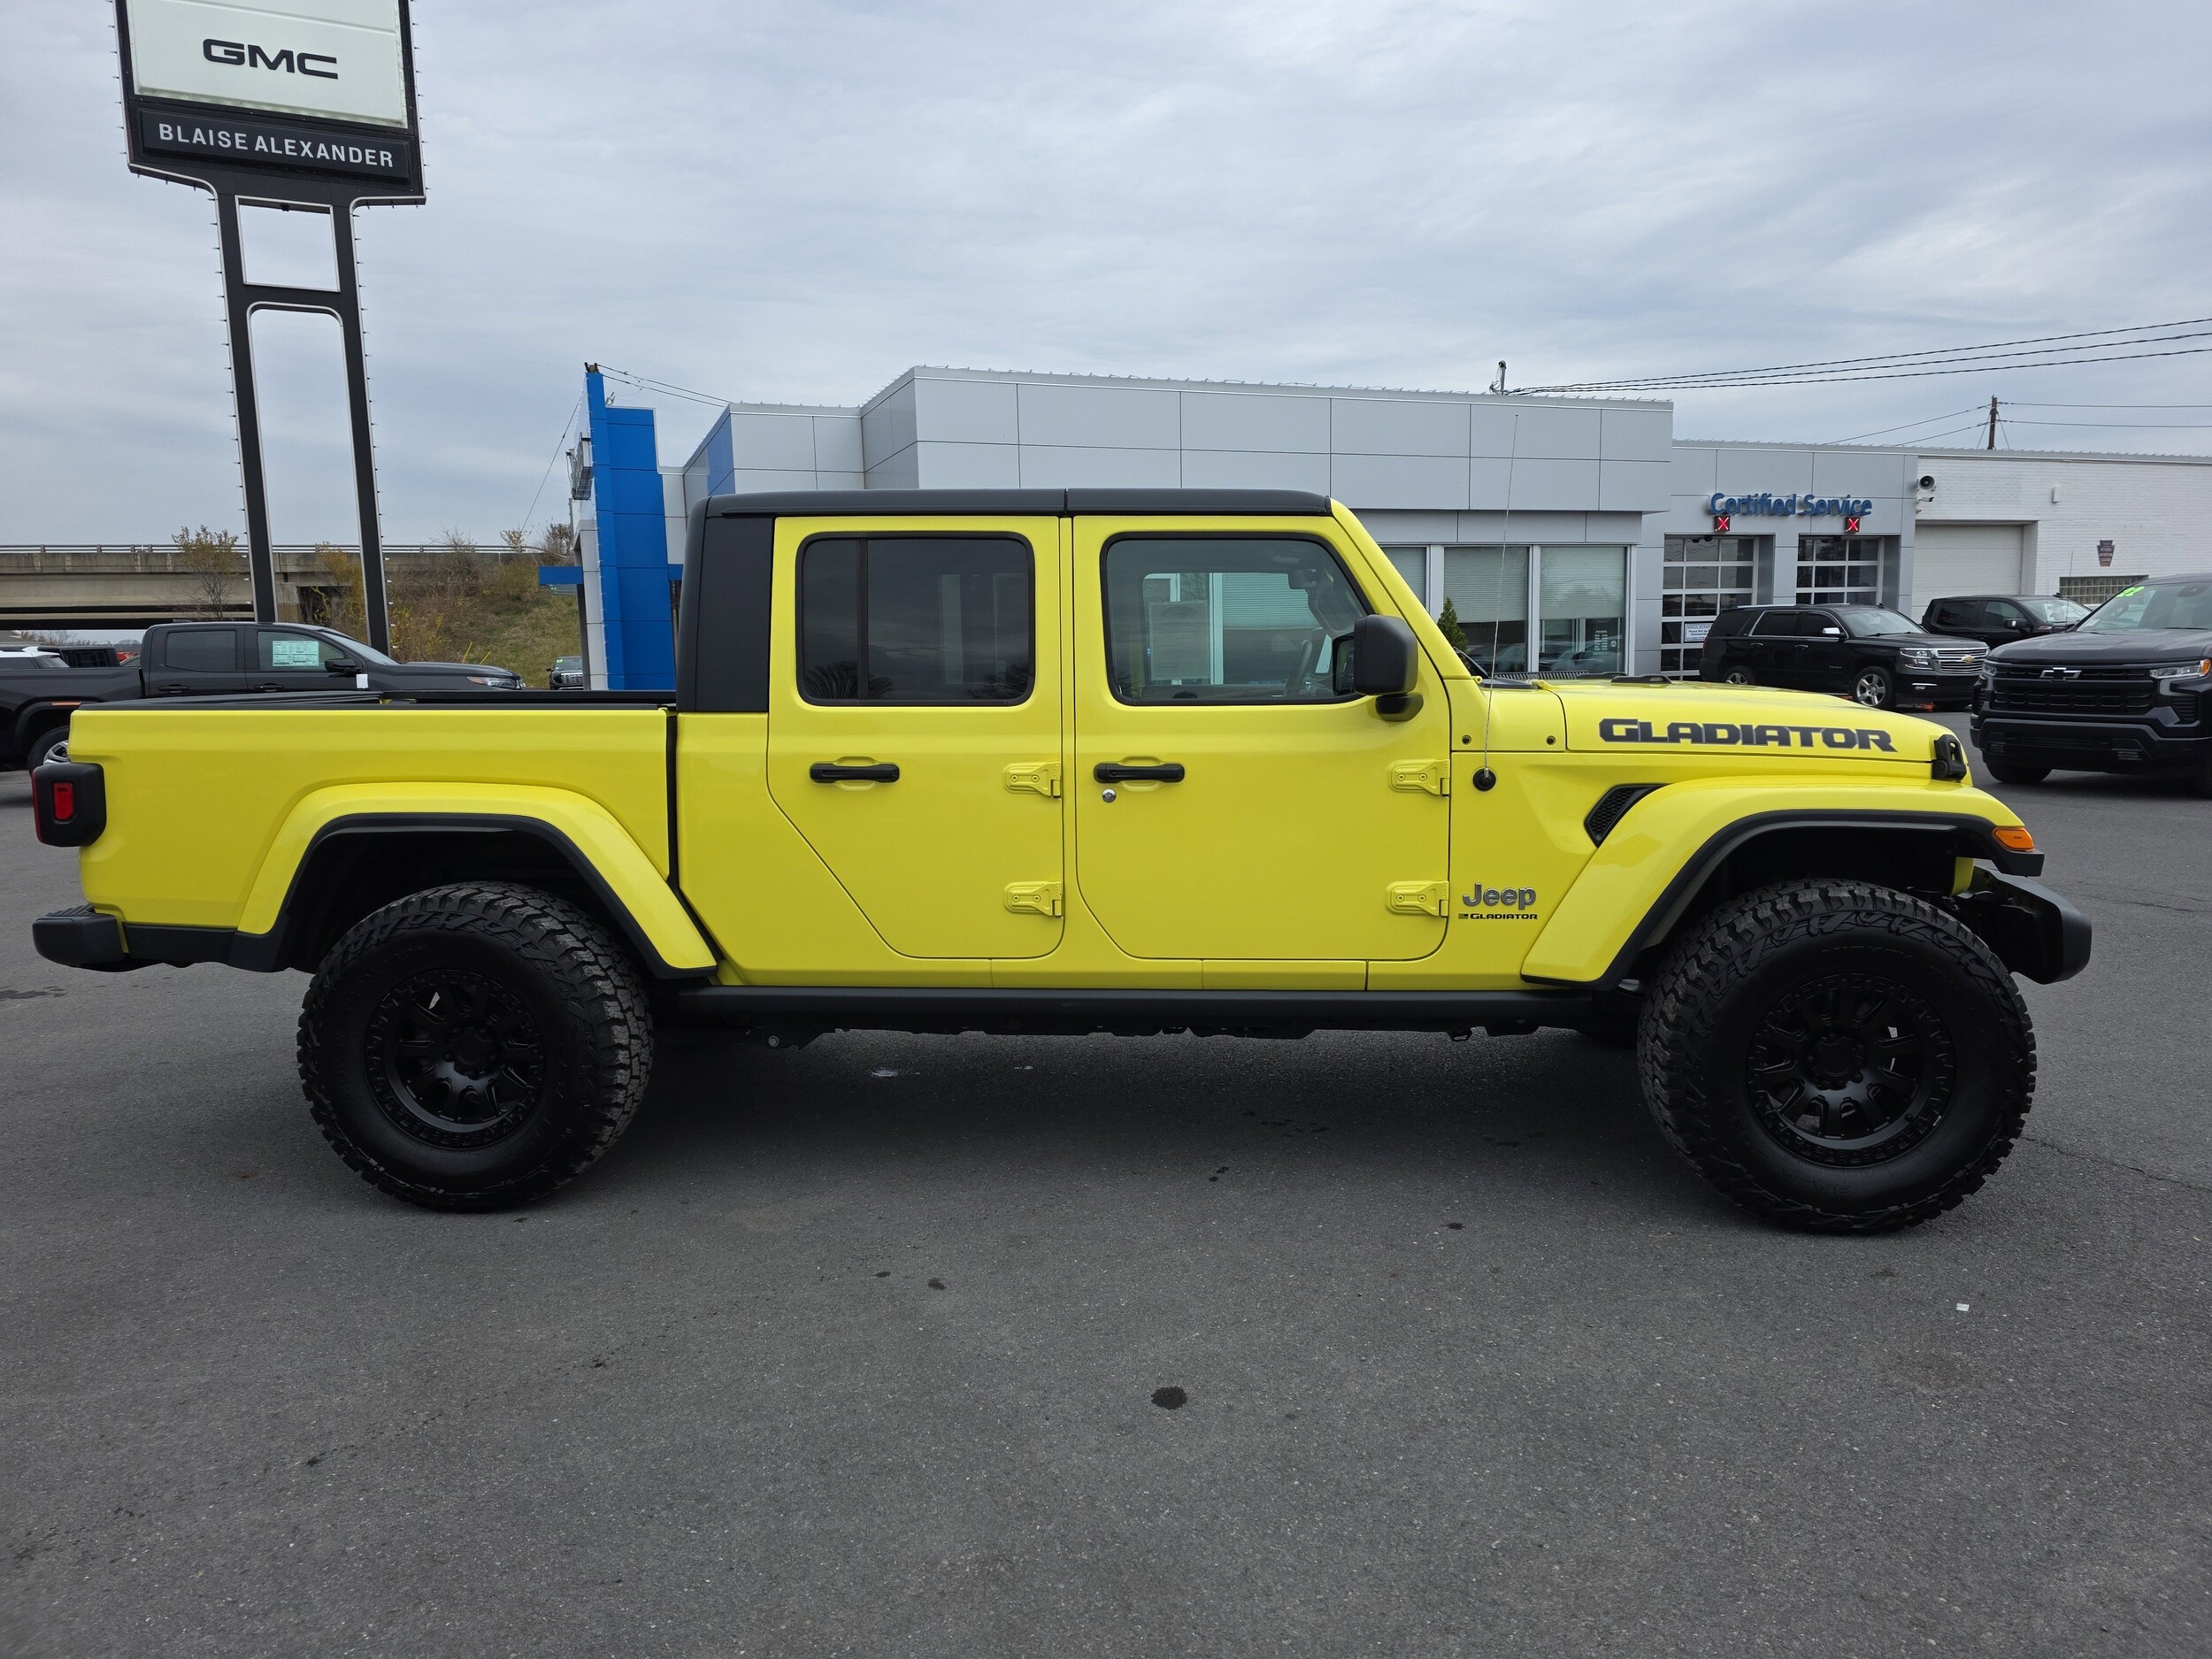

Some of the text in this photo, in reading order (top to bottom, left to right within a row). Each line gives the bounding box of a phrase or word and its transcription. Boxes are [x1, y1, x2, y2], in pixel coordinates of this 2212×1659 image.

[202, 38, 339, 80] GMC
[158, 123, 394, 168] BLAISE ALEXANDER
[1709, 492, 1873, 516] Certified Service
[1599, 718, 1899, 753] GLADIATOR
[1462, 882, 1537, 910] Jeep
